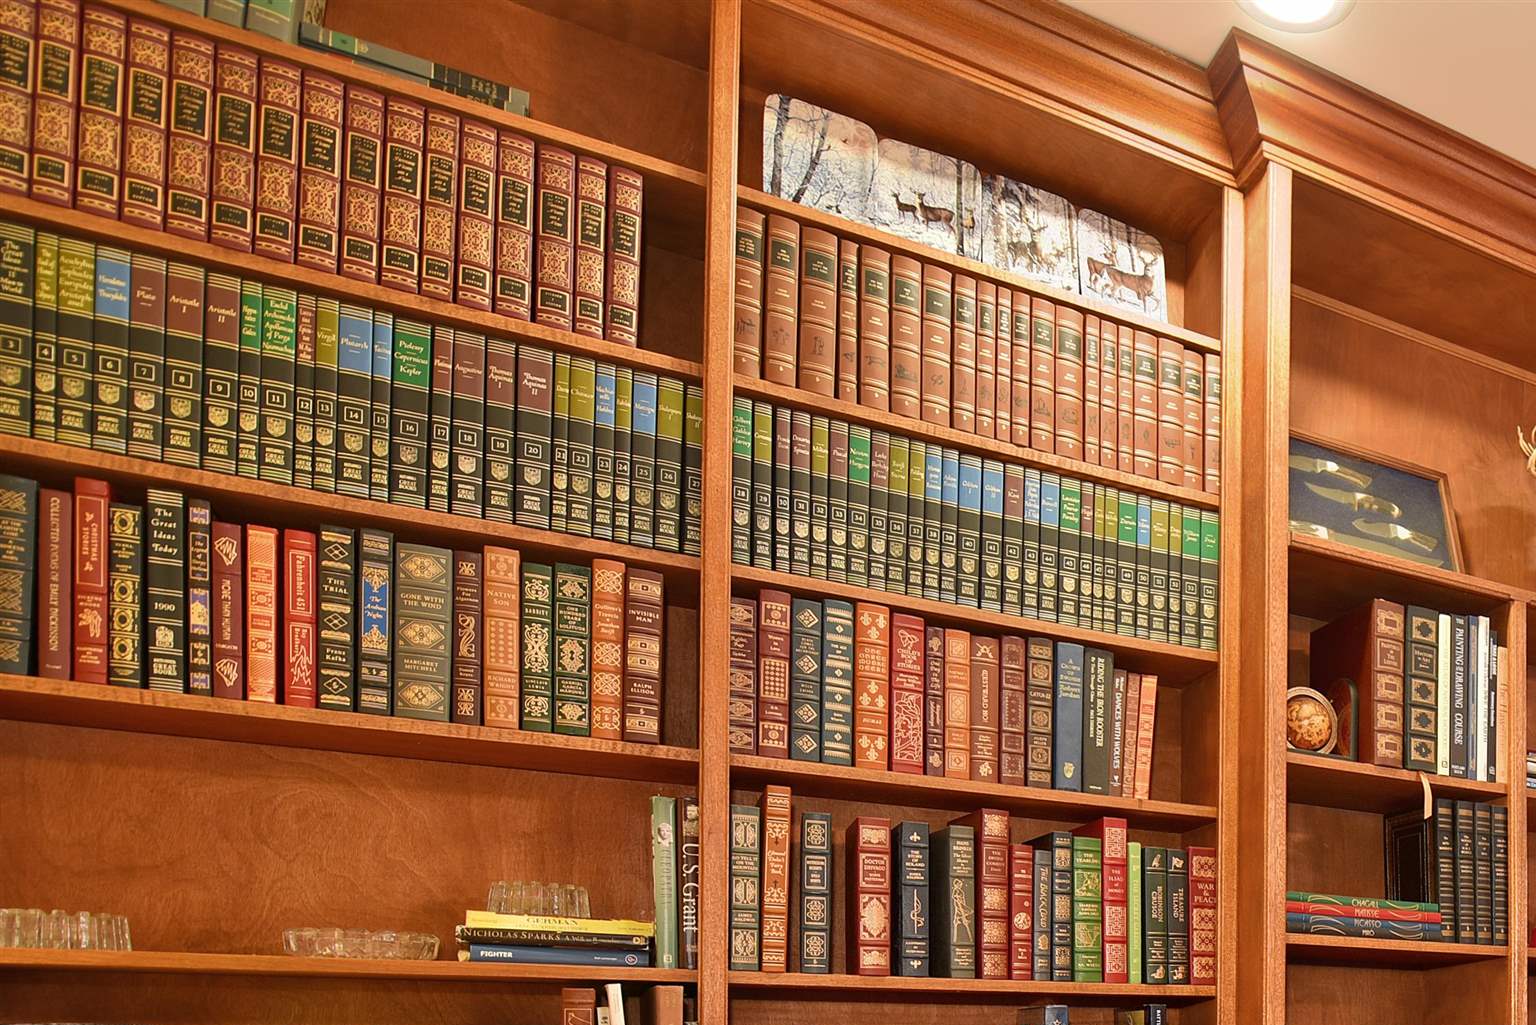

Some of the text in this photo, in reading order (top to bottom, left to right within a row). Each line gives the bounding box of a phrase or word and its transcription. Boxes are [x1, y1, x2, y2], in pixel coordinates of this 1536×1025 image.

[169, 294, 201, 307] Aristotle
[207, 304, 238, 318] Aristotle
[155, 508, 172, 517] The
[151, 519, 177, 529] Great
[153, 531, 176, 540] Ideas
[152, 543, 178, 555] Today
[296, 555, 305, 611] Fahrenheit 451
[327, 578, 345, 586] THE
[323, 585, 348, 595] TRIAL
[488, 590, 516, 600] NATIVE
[424, 596, 445, 604] WITH
[494, 598, 510, 607] SON
[154, 602, 176, 612] 1990
[595, 604, 621, 612] Gulliver's
[560, 610, 586, 618] HUNDRED
[629, 610, 659, 619] INVISIBLE
[153, 662, 177, 670] GREAT
[404, 659, 439, 668] MARGARET
[405, 664, 437, 672] MITCHELL
[153, 668, 177, 676] BOOKS
[1097, 657, 1105, 683] RIDING
[488, 675, 516, 684] RICHARD
[489, 681, 515, 690] WRIGHT
[1454, 627, 1464, 745] PAINTING DRAWING COURSE
[1030, 691, 1051, 699] CATCH-22
[1096, 699, 1104, 717] IRON
[1096, 718, 1104, 747] ROOSTER
[1113, 740, 1121, 769] WOLVES
[1040, 867, 1048, 880] THE
[682, 882, 699, 931] Grant
[1352, 899, 1379, 908] CHAGALL
[1354, 909, 1380, 918] MATISSE
[526, 917, 578, 926] GERMAN
[1354, 919, 1382, 928] PICASSO
[464, 928, 560, 942] NICHOLAS SPARKS
[480, 950, 513, 958] FIGHTER
